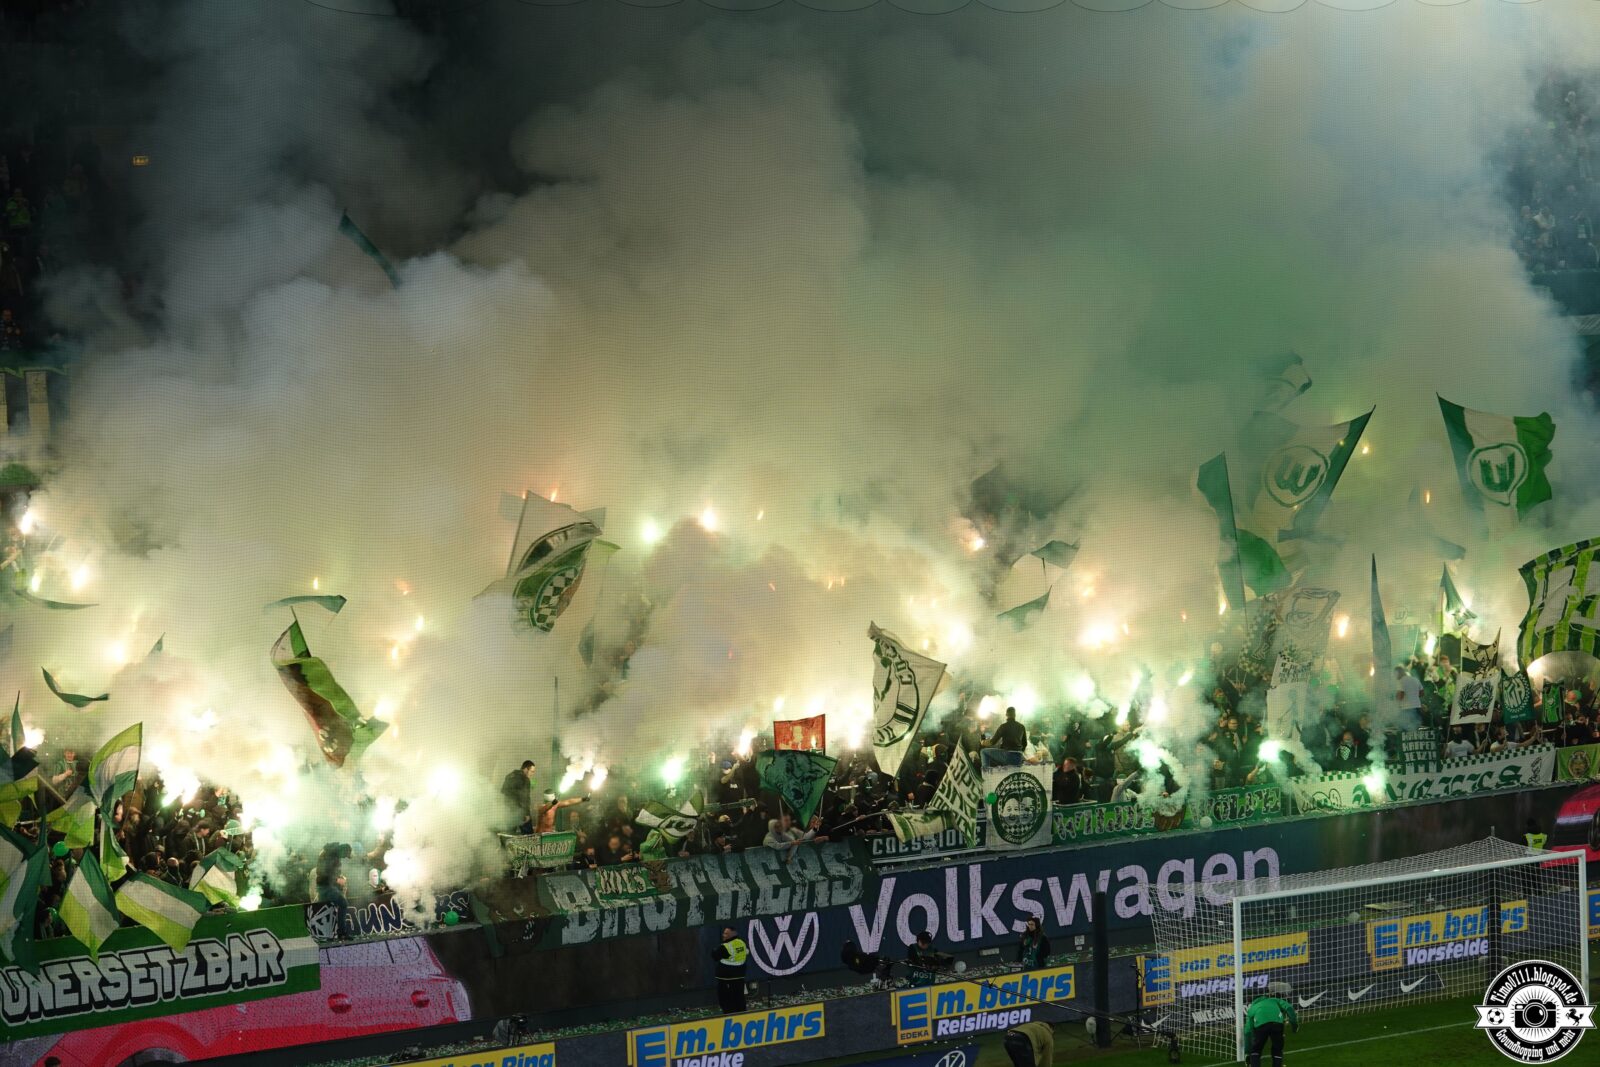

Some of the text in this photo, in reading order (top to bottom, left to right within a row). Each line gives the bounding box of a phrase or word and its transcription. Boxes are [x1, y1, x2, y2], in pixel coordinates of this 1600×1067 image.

[848, 843, 1281, 953] Volkswagen
[1179, 958, 1211, 973] von
[1407, 937, 1489, 966] Vorsfelde
[1, 929, 287, 1027] UNERSETZBAR
[978, 972, 1073, 1009] bahrs
[720, 1011, 823, 1050] bahrs
[900, 1030, 930, 1040] EDEKA
[937, 1008, 1031, 1037] Reislingen
